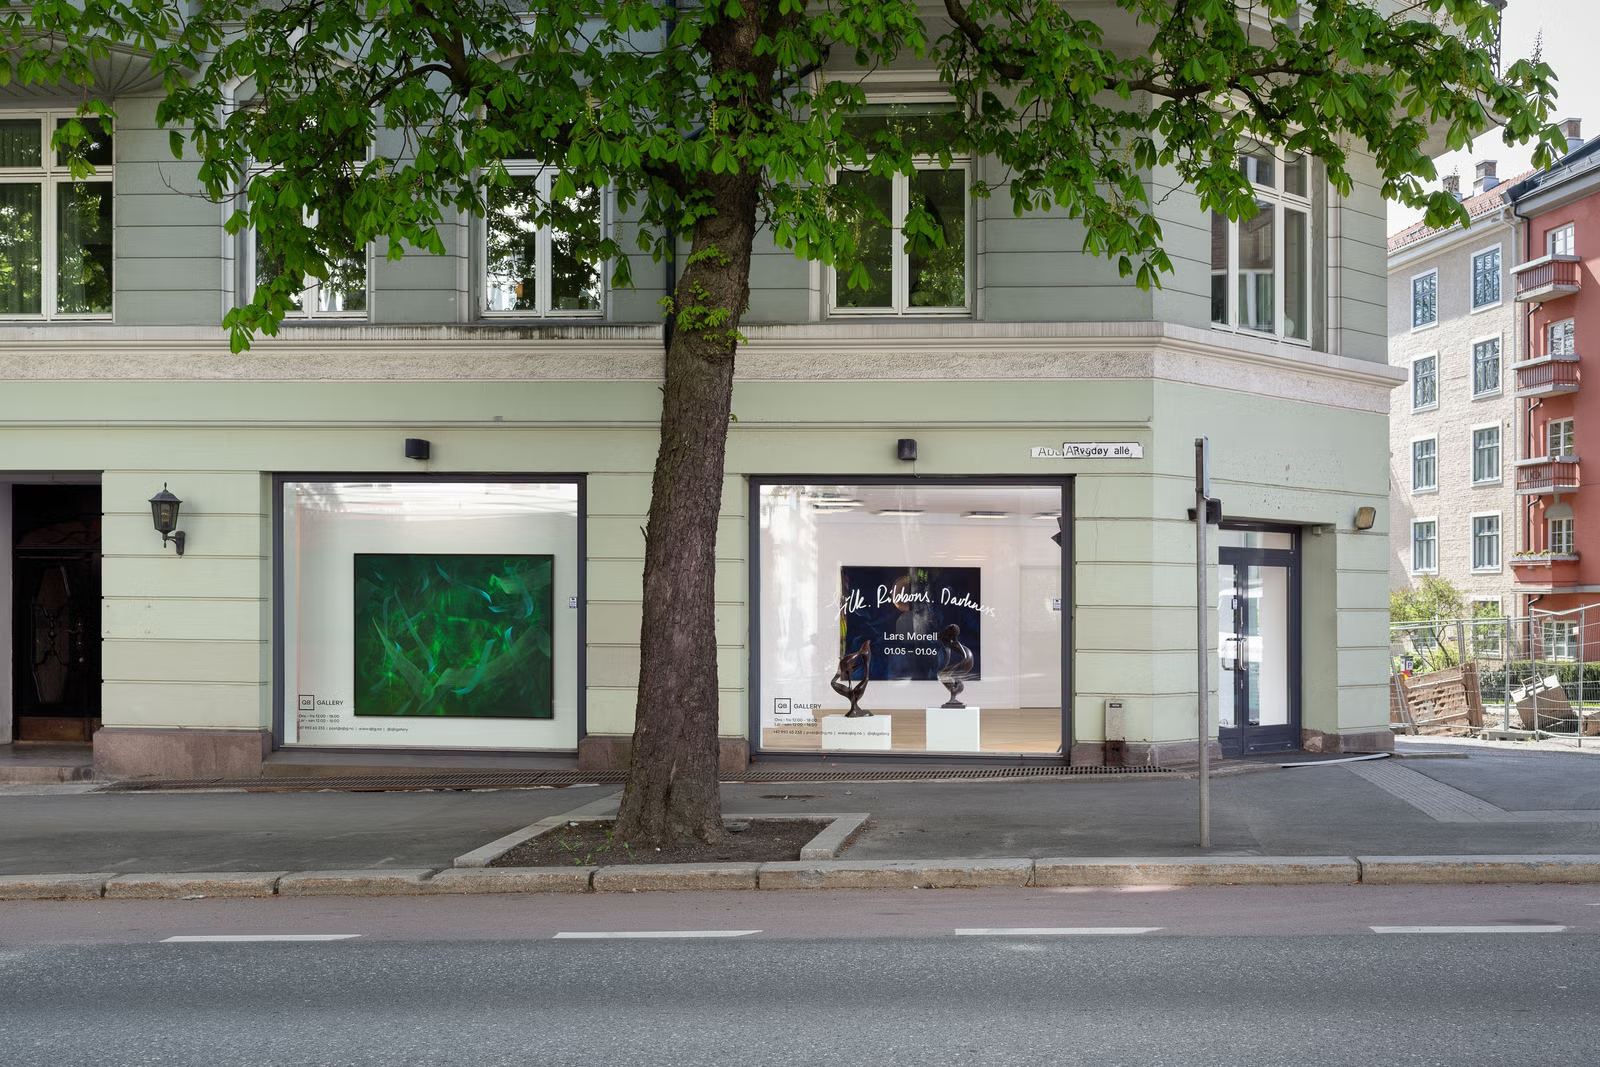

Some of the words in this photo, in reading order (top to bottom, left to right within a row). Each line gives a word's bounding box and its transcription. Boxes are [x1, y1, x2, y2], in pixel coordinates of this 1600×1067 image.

[883, 631, 905, 641] Lars
[907, 631, 938, 641] Morell
[883, 647, 906, 656] 01.05
[915, 647, 938, 656] 01.06
